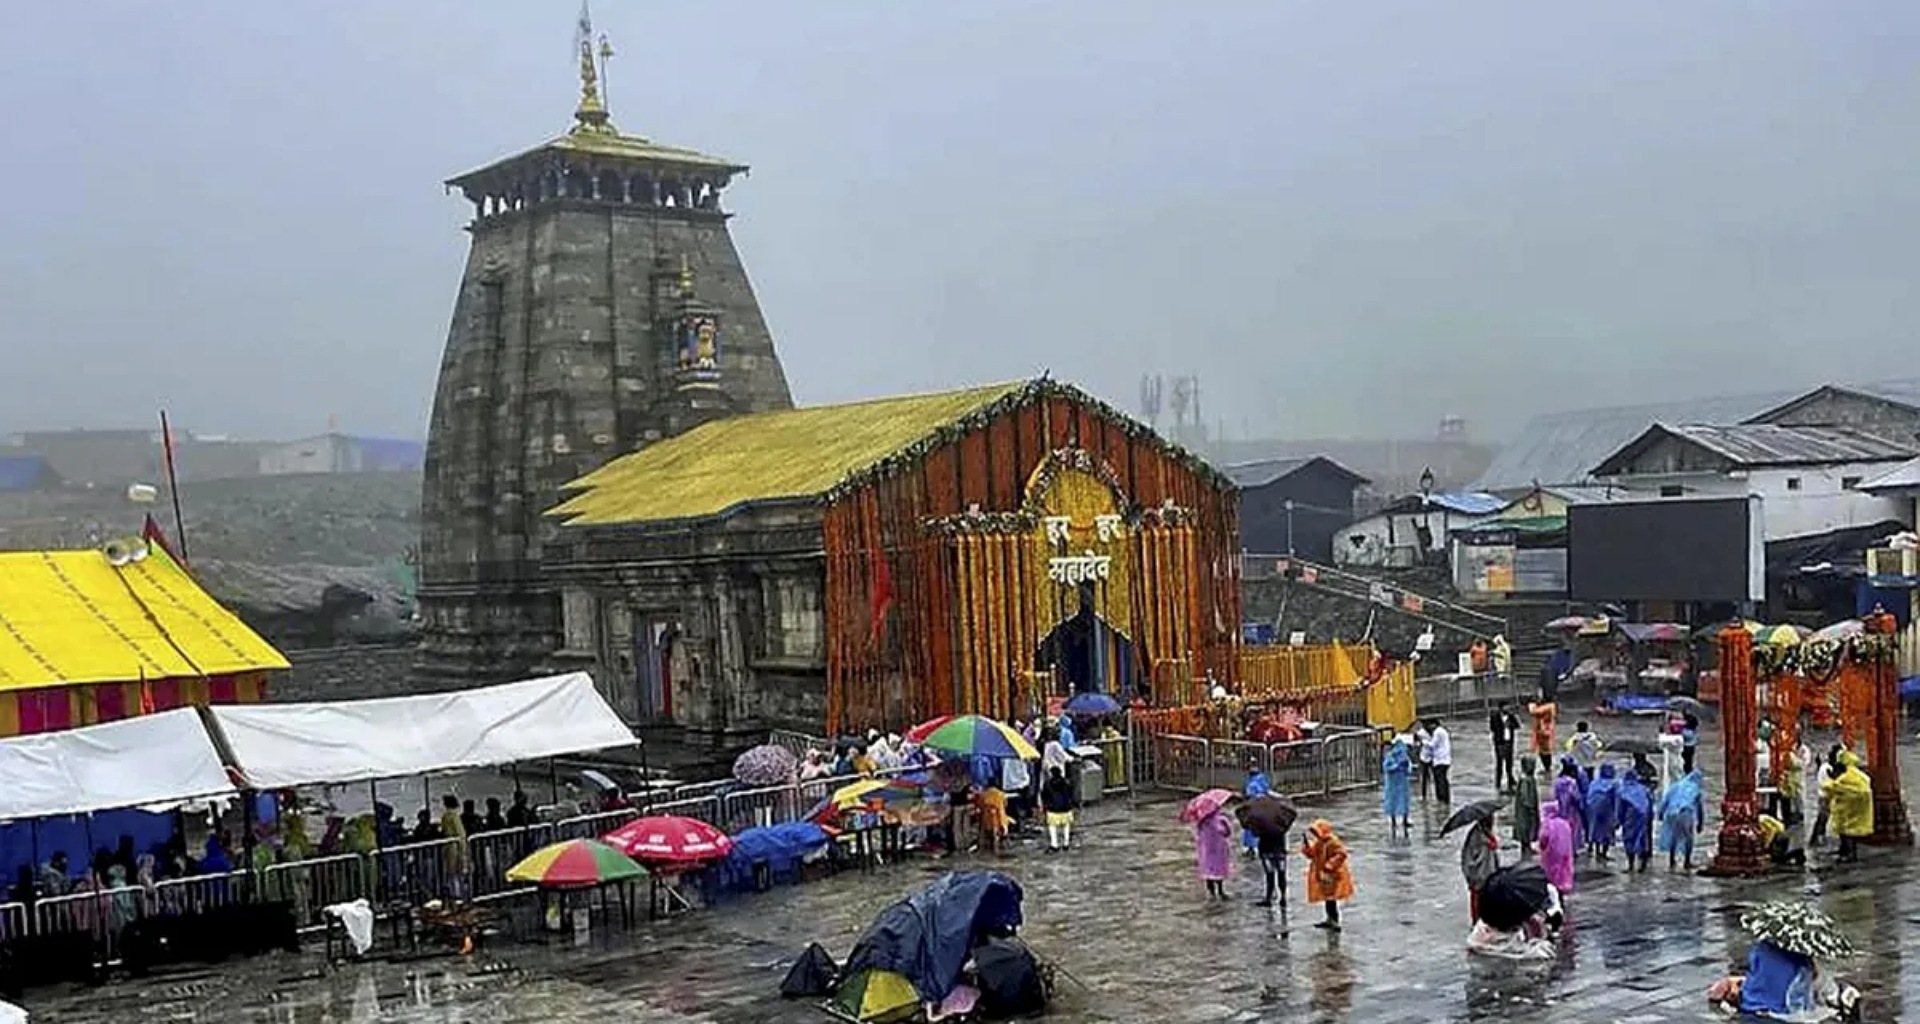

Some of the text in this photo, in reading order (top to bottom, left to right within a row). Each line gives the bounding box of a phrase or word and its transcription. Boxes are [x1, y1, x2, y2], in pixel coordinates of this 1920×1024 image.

[1045, 515, 1122, 546] हर हर
[1049, 549, 1112, 586] महादेव
